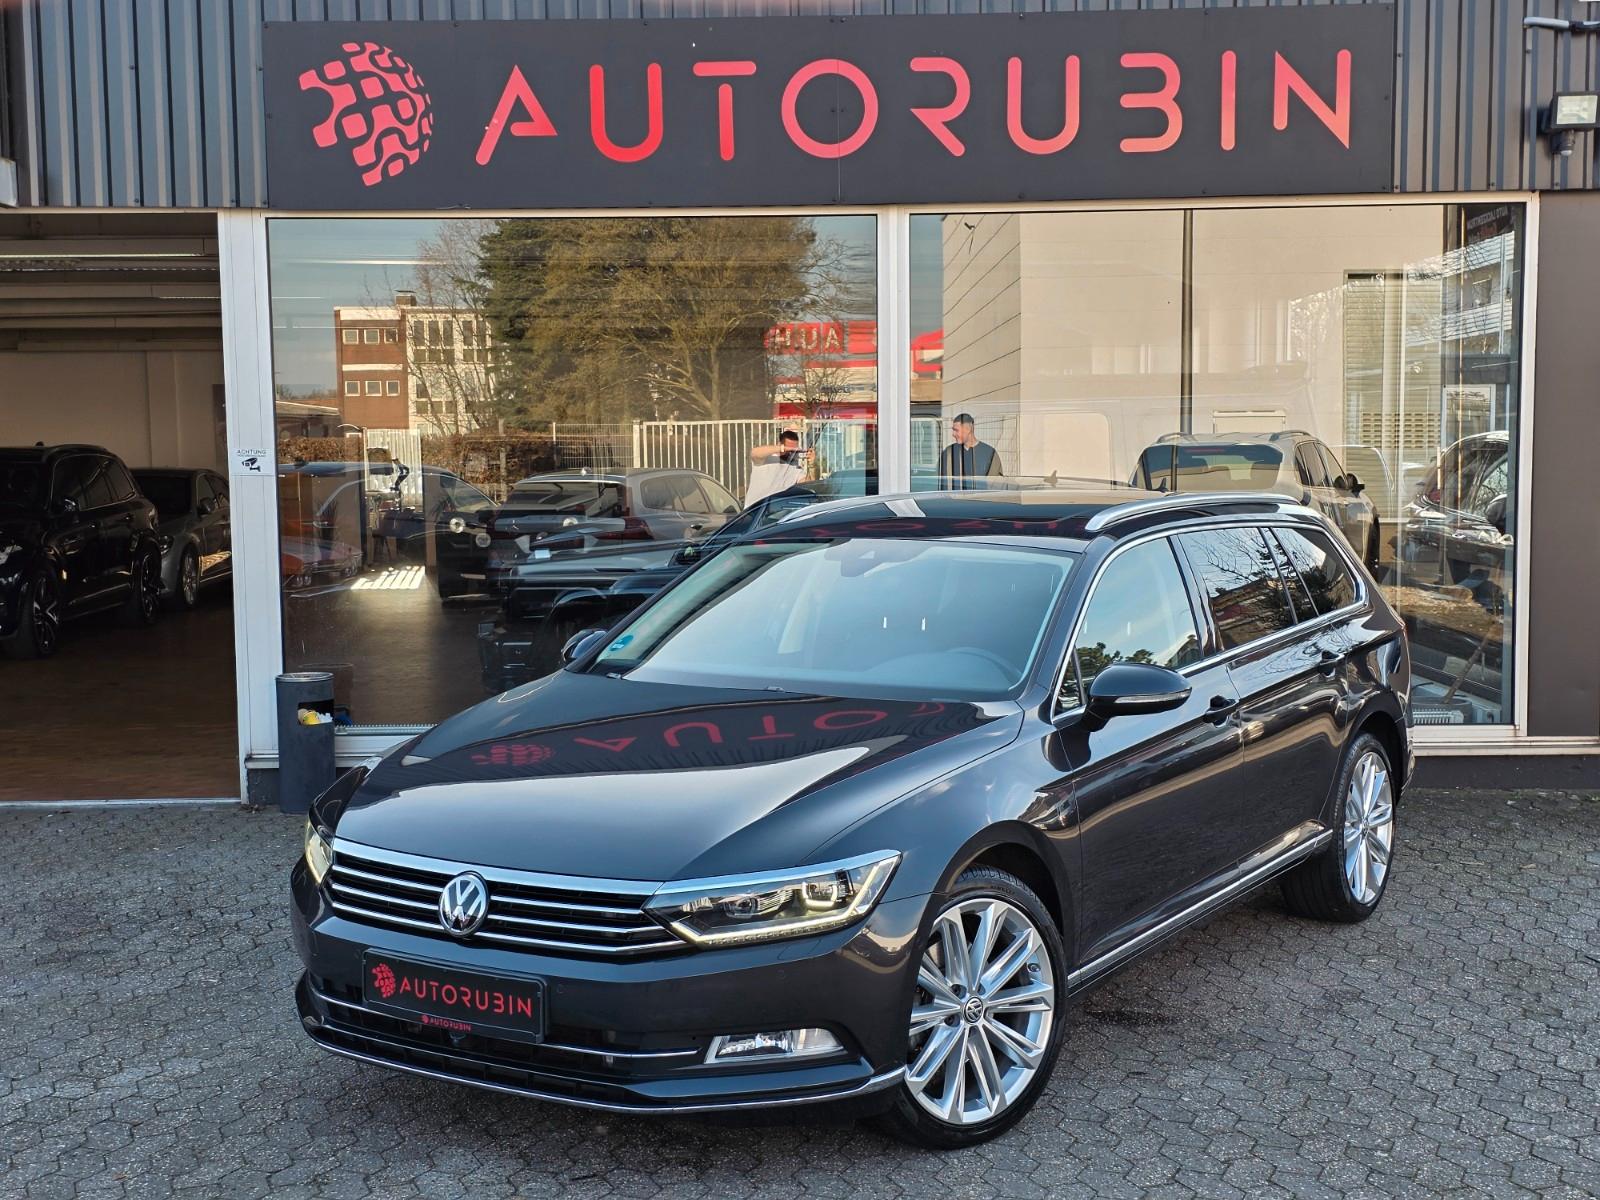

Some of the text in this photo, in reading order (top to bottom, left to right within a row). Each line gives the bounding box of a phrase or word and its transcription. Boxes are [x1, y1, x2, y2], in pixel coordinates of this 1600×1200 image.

[476, 49, 1353, 166] AUTORUBIN
[399, 976, 533, 1018] AUTORUBIN
[430, 1017, 472, 1032] AUTORUBIN
